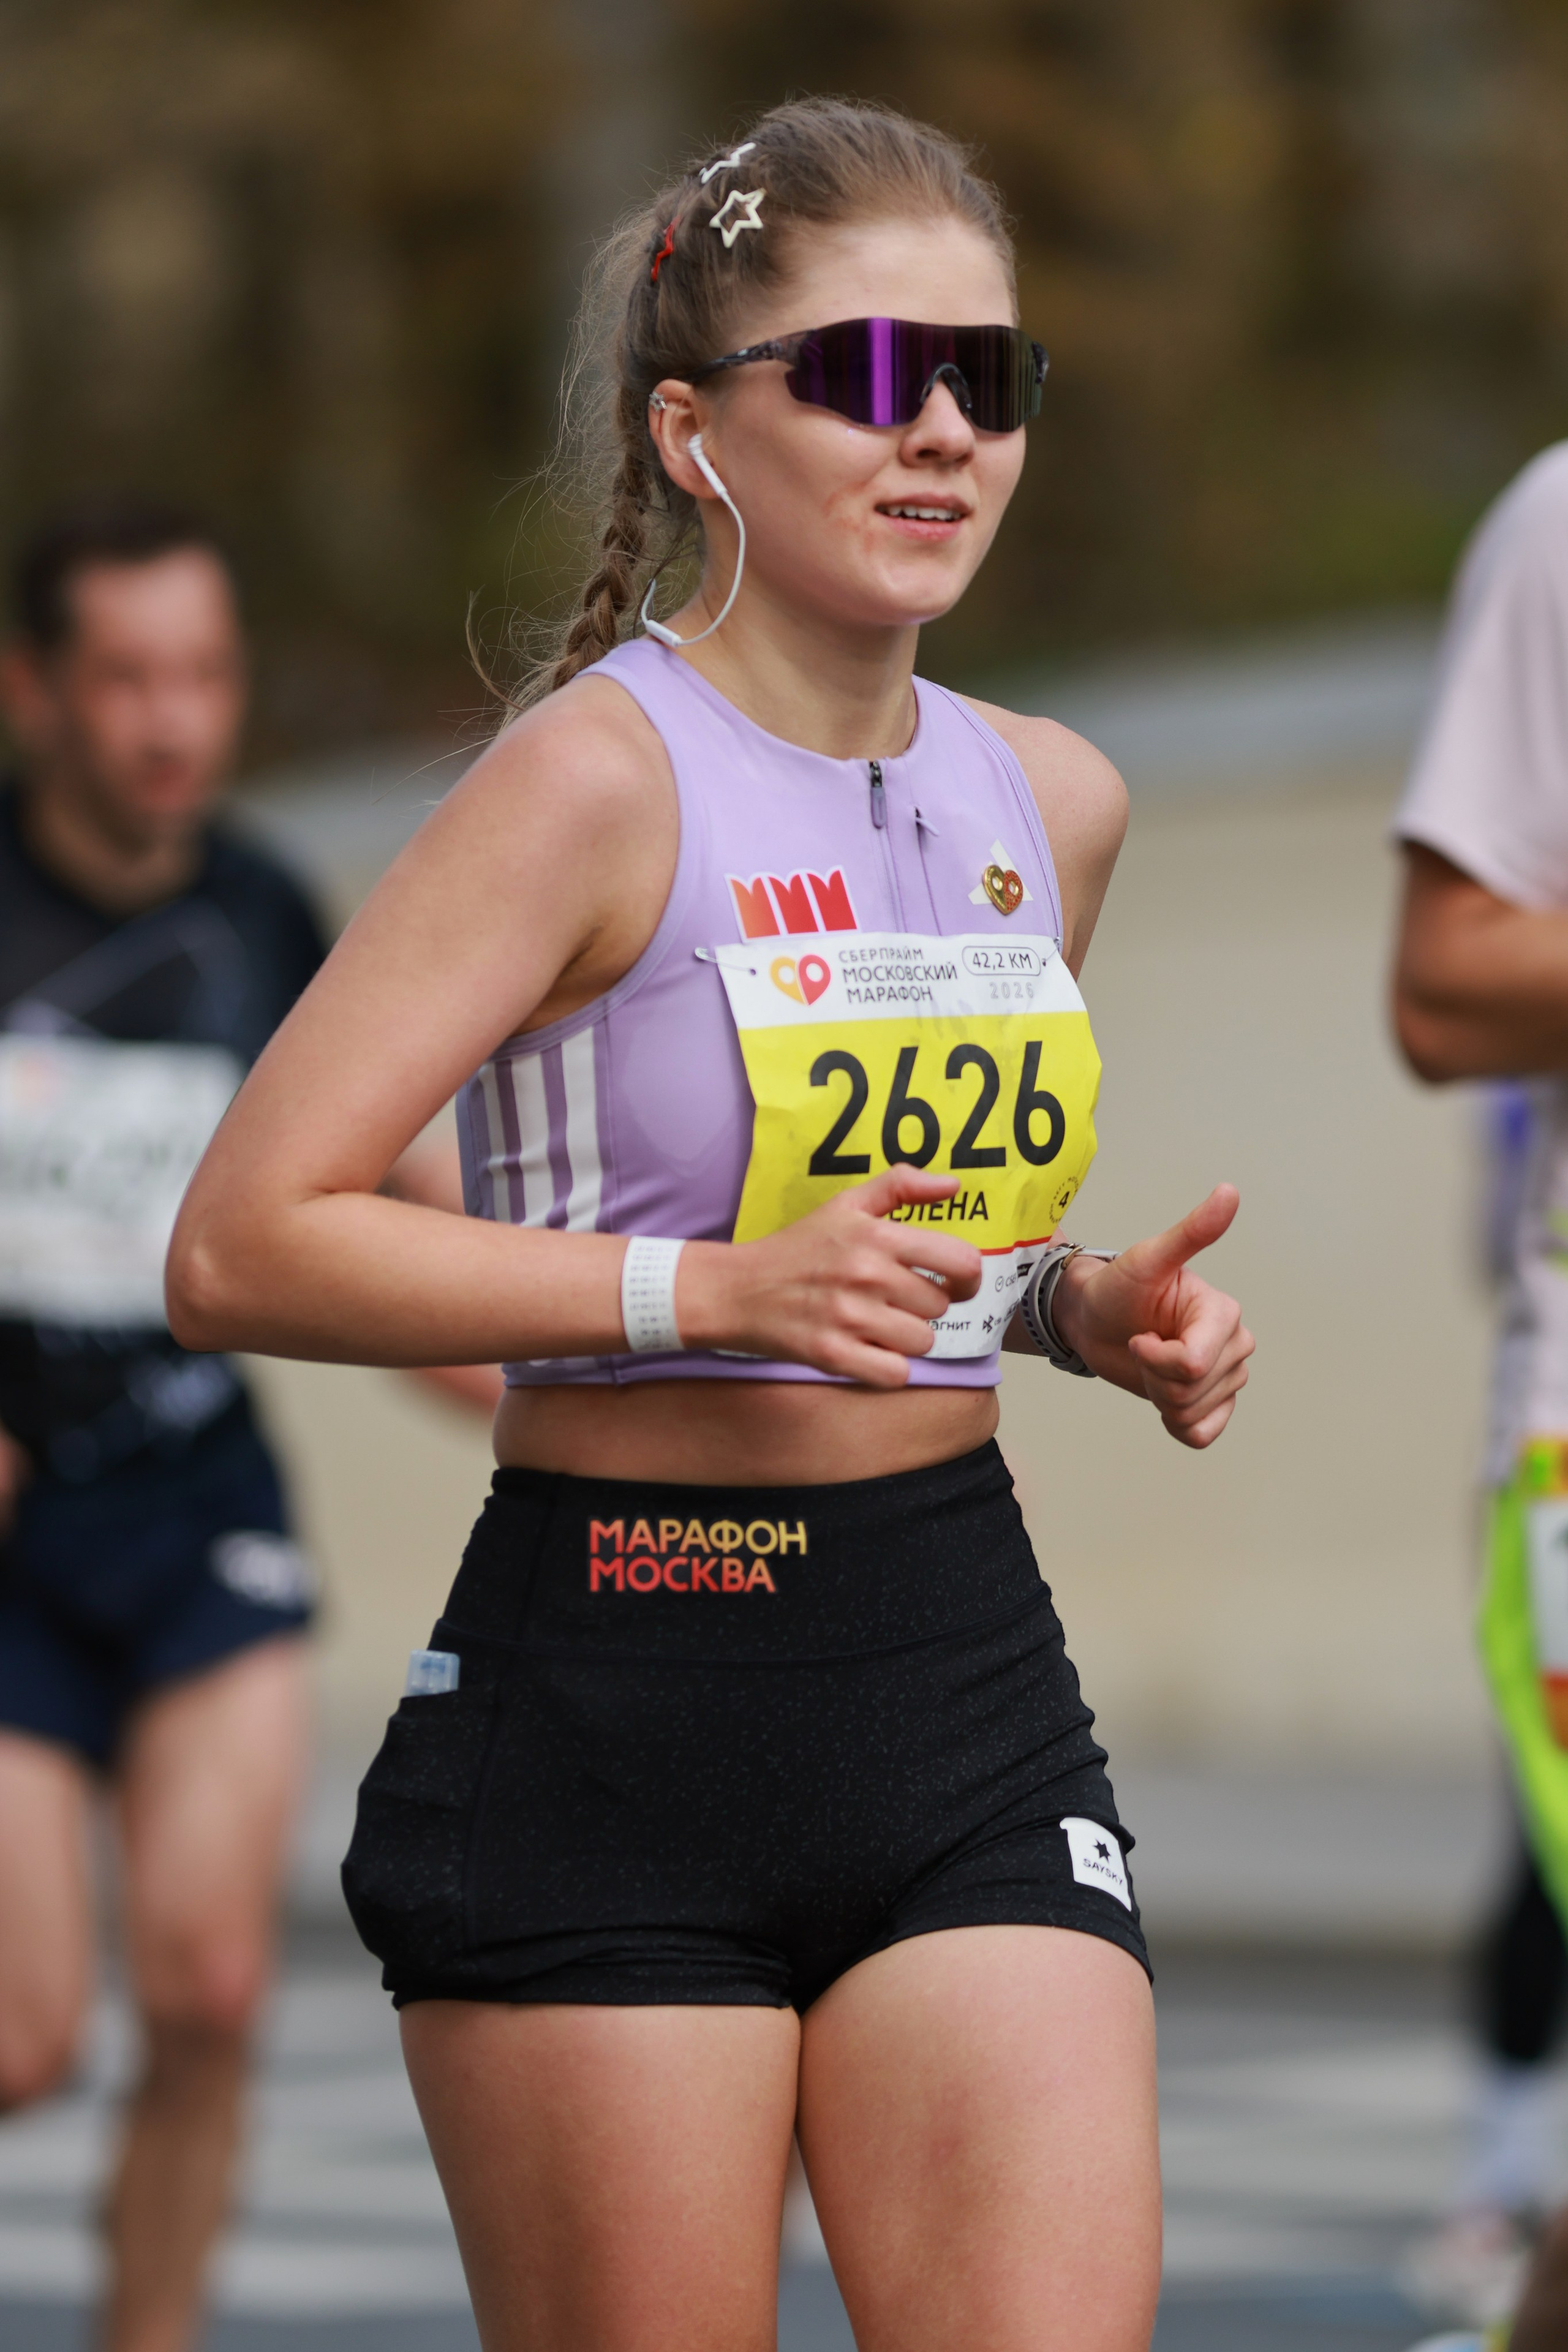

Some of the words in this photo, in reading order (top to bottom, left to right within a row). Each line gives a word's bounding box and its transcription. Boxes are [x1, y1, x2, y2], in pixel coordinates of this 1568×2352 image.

[839, 946, 924, 963] СБЕРПРАЙМ
[973, 952, 1005, 970] 42,2
[843, 962, 957, 983] МОСКОВСКИЙ
[847, 986, 933, 1003] МАРАФОН
[989, 982, 1033, 999] 2026
[809, 1041, 1066, 1176] 2626
[1058, 1191, 1070, 1208] 4
[927, 1321, 971, 1330] агнит
[590, 1519, 807, 1555] МАРАФОН
[590, 1556, 775, 1593] МОСКВА
